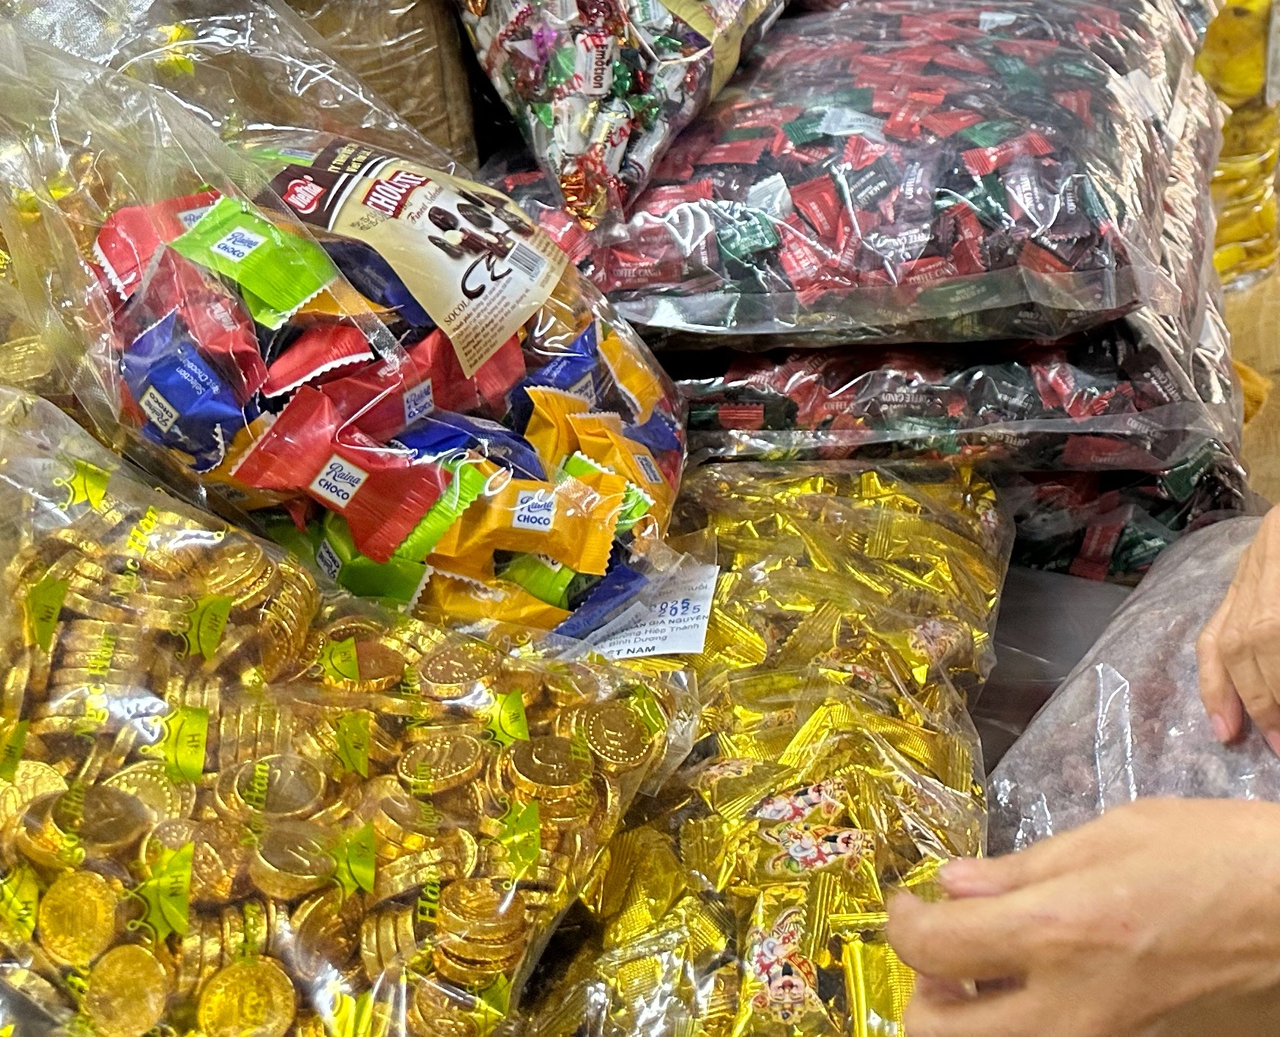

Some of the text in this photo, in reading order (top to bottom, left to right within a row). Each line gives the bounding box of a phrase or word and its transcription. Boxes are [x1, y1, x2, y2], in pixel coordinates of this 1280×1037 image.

[225, 231, 259, 250] Raina
[216, 242, 245, 259] CHOCO
[175, 366, 203, 396] Selection
[149, 391, 174, 419] CHOCO
[329, 462, 361, 489] Raina
[317, 478, 350, 501] CHOCO
[517, 513, 551, 526] CHOCO
[644, 627, 667, 636] Hiệp
[669, 624, 700, 633] Thành
[648, 619, 666, 627] GIA
[633, 634, 668, 645] Dương
[626, 645, 656, 655] NAM
